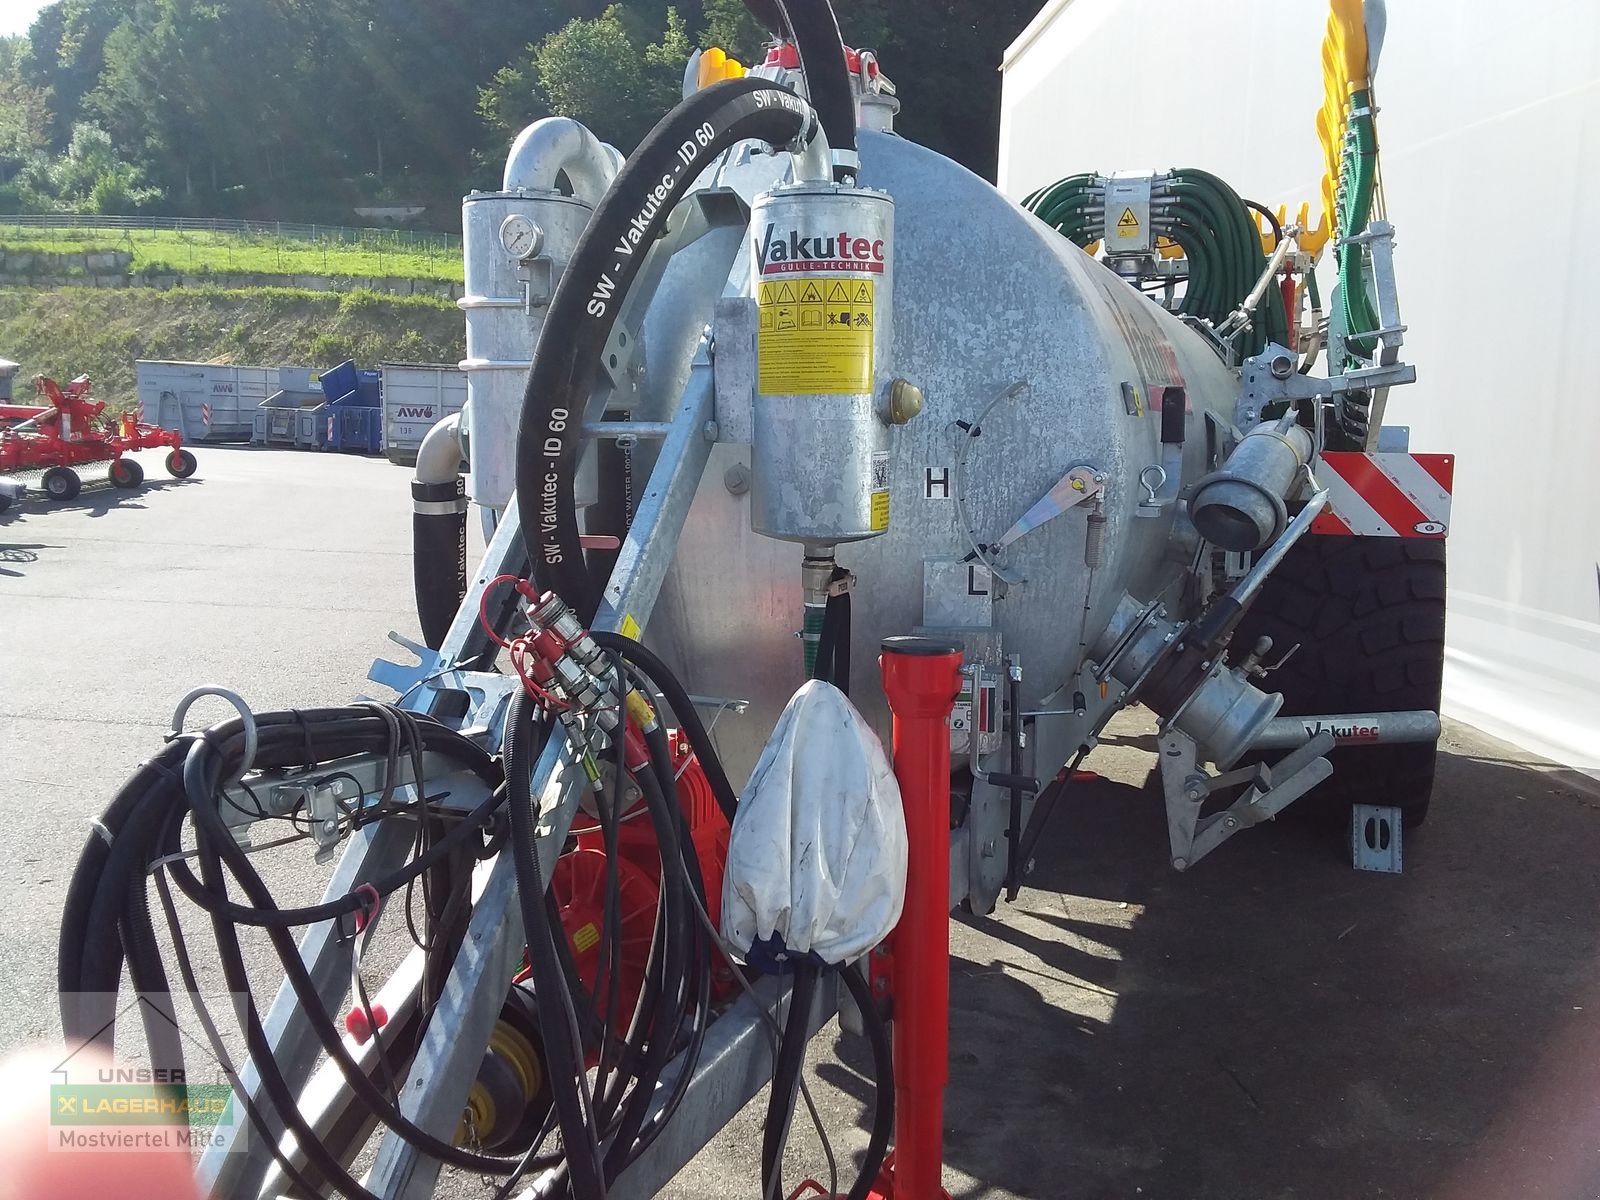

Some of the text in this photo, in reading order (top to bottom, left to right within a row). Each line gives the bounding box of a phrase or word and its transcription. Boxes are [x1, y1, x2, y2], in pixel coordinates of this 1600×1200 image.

[754, 89, 771, 108] SW
[587, 273, 616, 317] SW
[615, 173, 675, 256] Vakutec
[677, 141, 698, 166] ID
[695, 122, 715, 146] 60
[755, 223, 885, 275] Vakutec
[549, 408, 569, 432] 60
[543, 437, 562, 457] ID
[927, 468, 949, 498] H
[540, 473, 558, 533] Vakutec
[544, 544, 563, 564] SW
[968, 565, 988, 595] L
